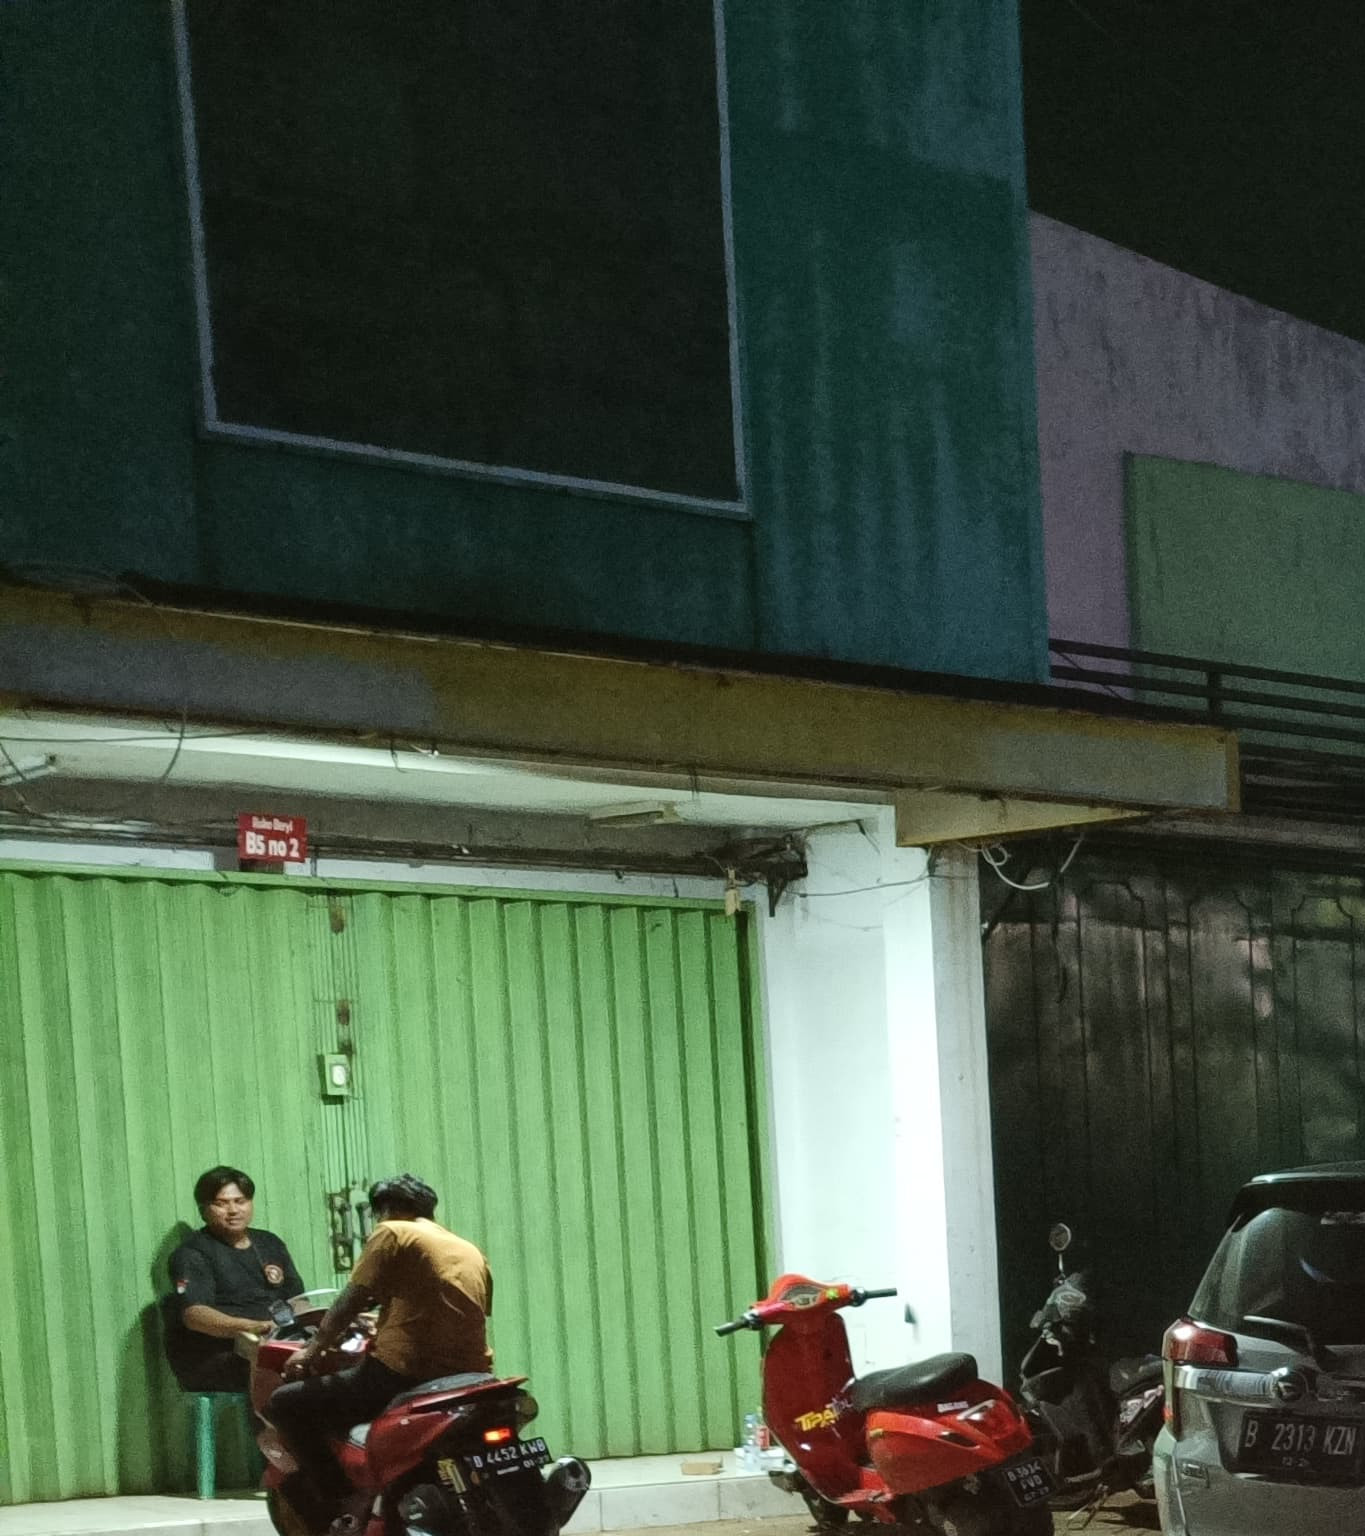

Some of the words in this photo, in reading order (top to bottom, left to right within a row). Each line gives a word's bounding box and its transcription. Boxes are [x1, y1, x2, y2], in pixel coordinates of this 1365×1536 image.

[268, 839, 288, 858] no
[289, 838, 301, 859] 2
[1244, 1420, 1259, 1448] B
[1271, 1422, 1318, 1452] 2313
[1322, 1424, 1357, 1456] KZN
